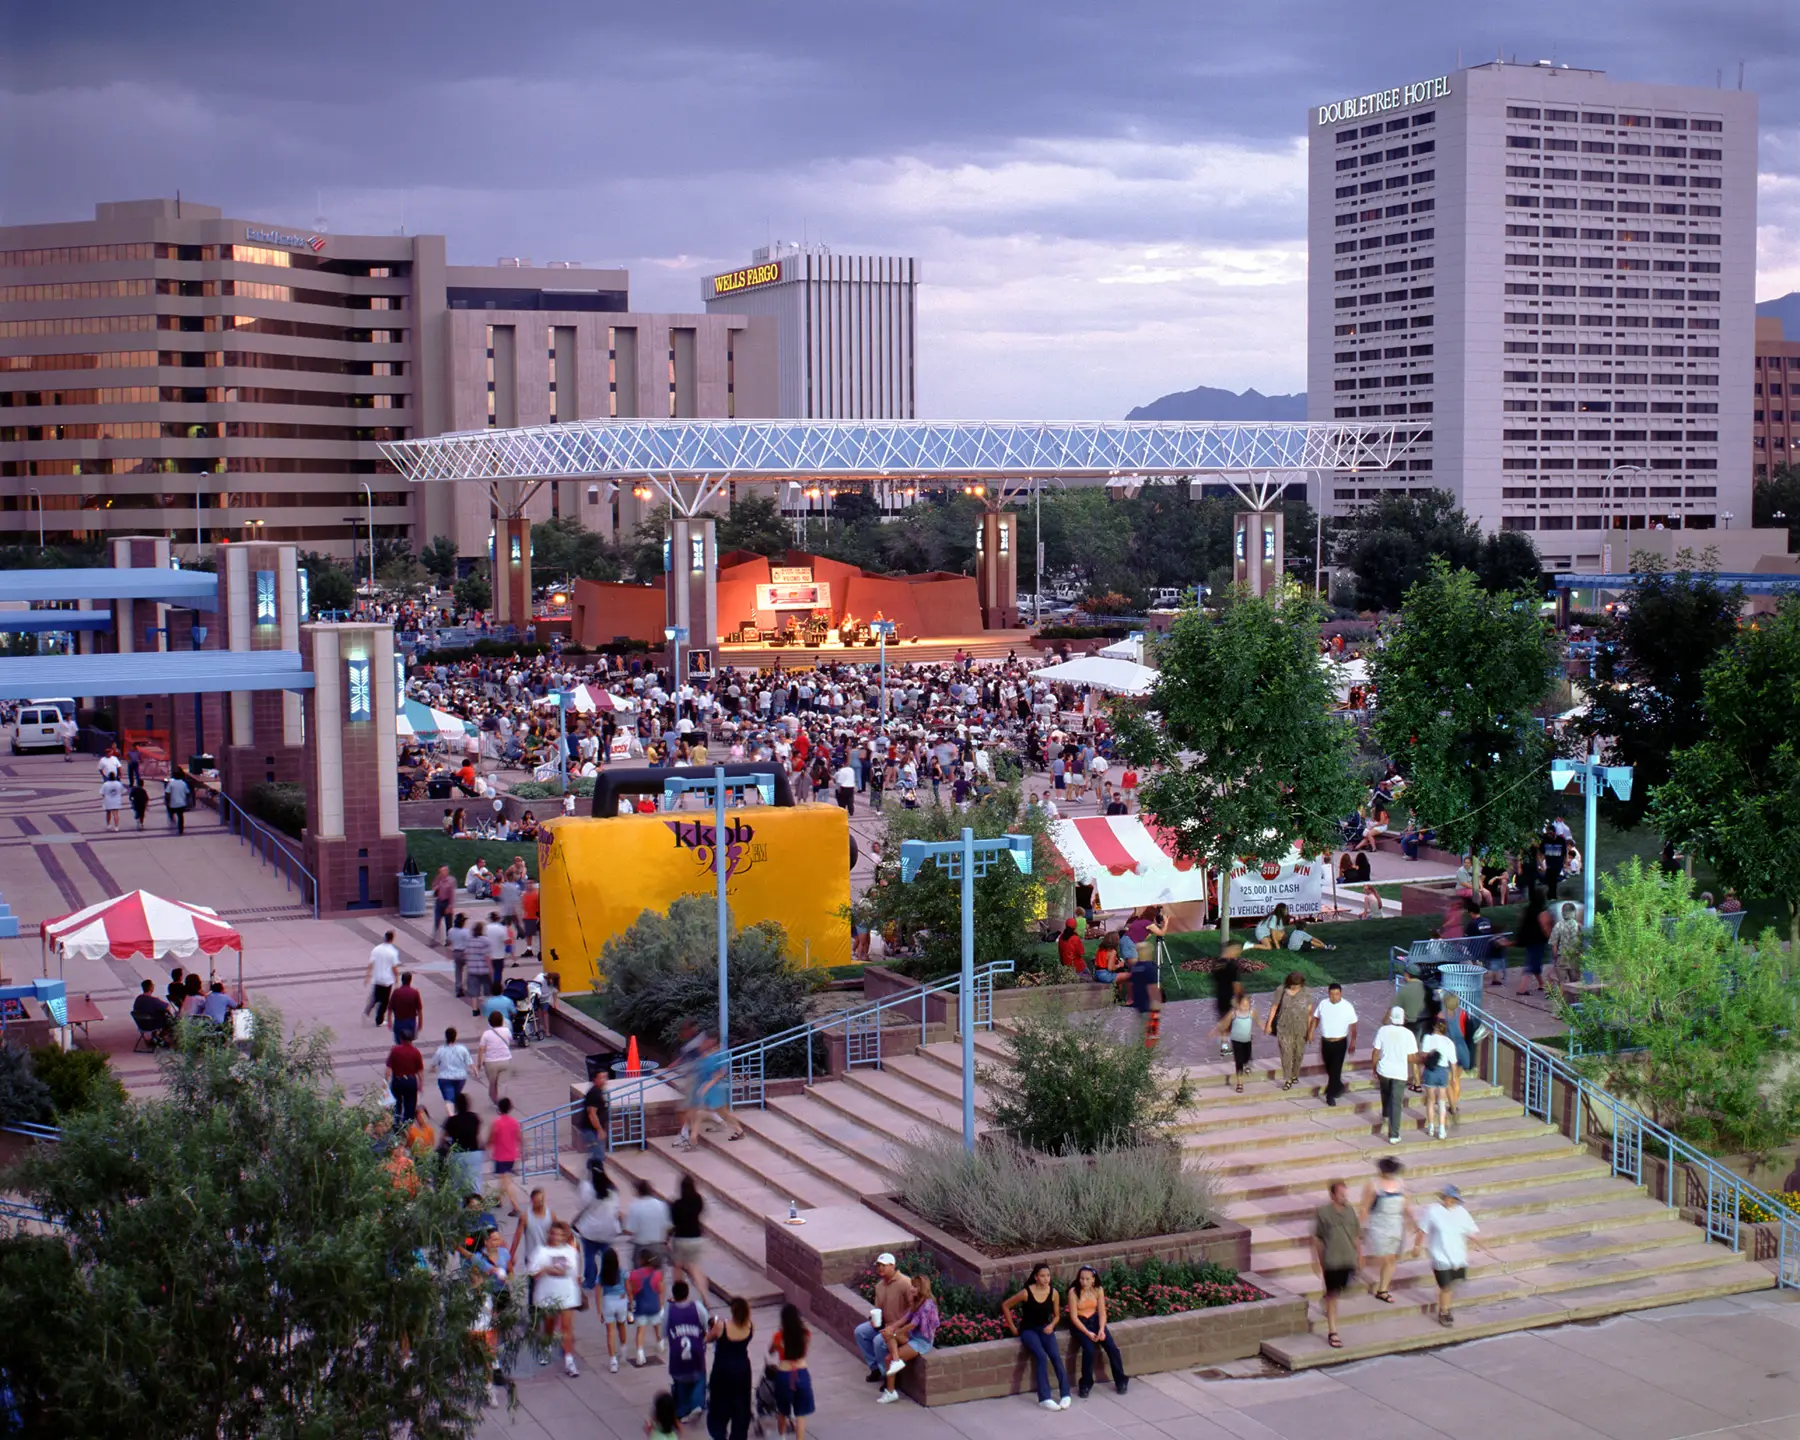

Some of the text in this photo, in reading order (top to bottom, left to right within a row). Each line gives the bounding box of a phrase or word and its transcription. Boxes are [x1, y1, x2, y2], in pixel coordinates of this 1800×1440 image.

[1318, 76, 1452, 125] DOUBLETREE HOTEL
[715, 263, 778, 292] WELLS FARGO
[1230, 866, 1246, 879] WIN
[1262, 866, 1279, 875] STOP
[1294, 864, 1310, 876] WIN
[1240, 884, 1300, 896] $25,000 IN CASH
[1238, 905, 1265, 915] VEHICLE
[1295, 903, 1319, 912] CHOICE
[680, 1336, 692, 1361] 2
